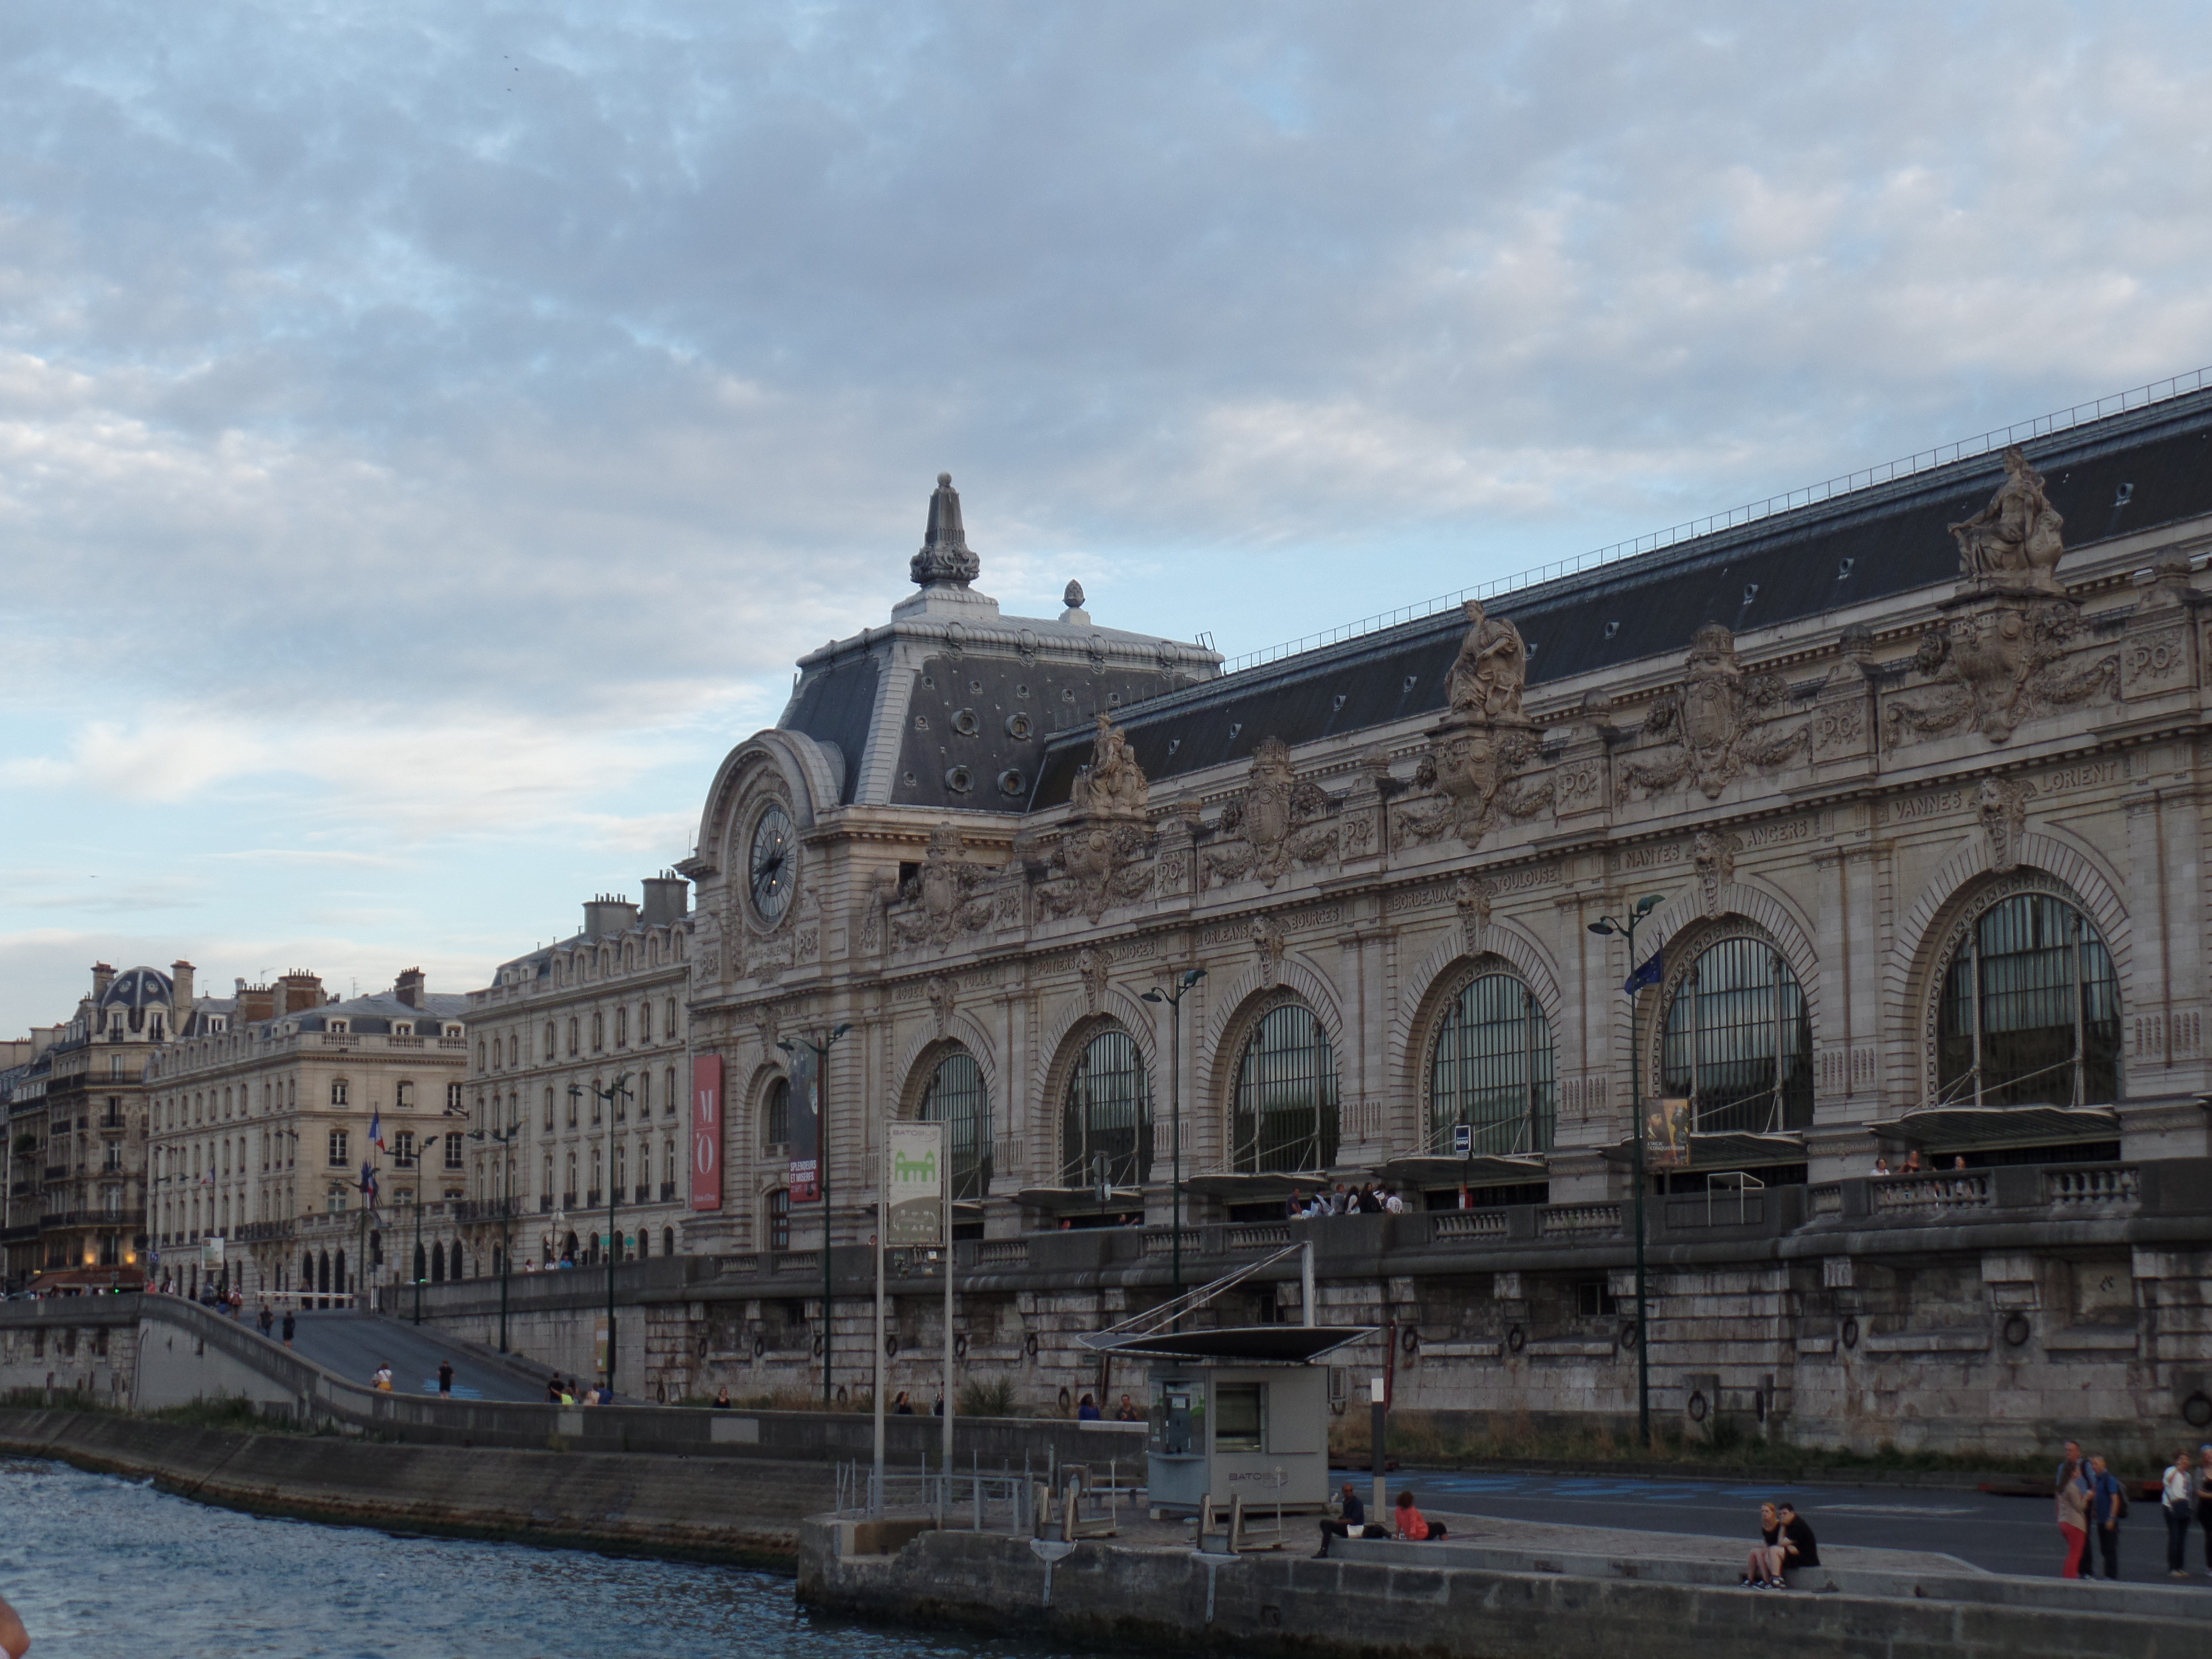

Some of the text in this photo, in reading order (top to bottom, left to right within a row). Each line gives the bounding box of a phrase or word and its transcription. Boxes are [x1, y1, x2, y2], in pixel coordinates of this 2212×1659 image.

[2133, 644, 2170, 673] PO
[1822, 715, 1853, 737] PO
[1563, 770, 1589, 796] PO
[2042, 762, 2118, 792] LORIENT
[1896, 791, 1962, 818] VANNES
[1346, 821, 1367, 842] PO
[1626, 820, 1806, 867] NANTES ANGERS
[1160, 863, 1178, 882] PO
[1394, 868, 1557, 909] BORDEAUX TOULOUSE
[1203, 907, 1339, 944] ORLEANS BOURGES
[1037, 942, 1155, 974] POITIERS LIMOGES
[791, 1160, 816, 1171] SPLENDEURS
[791, 1174, 795, 1183] ET
